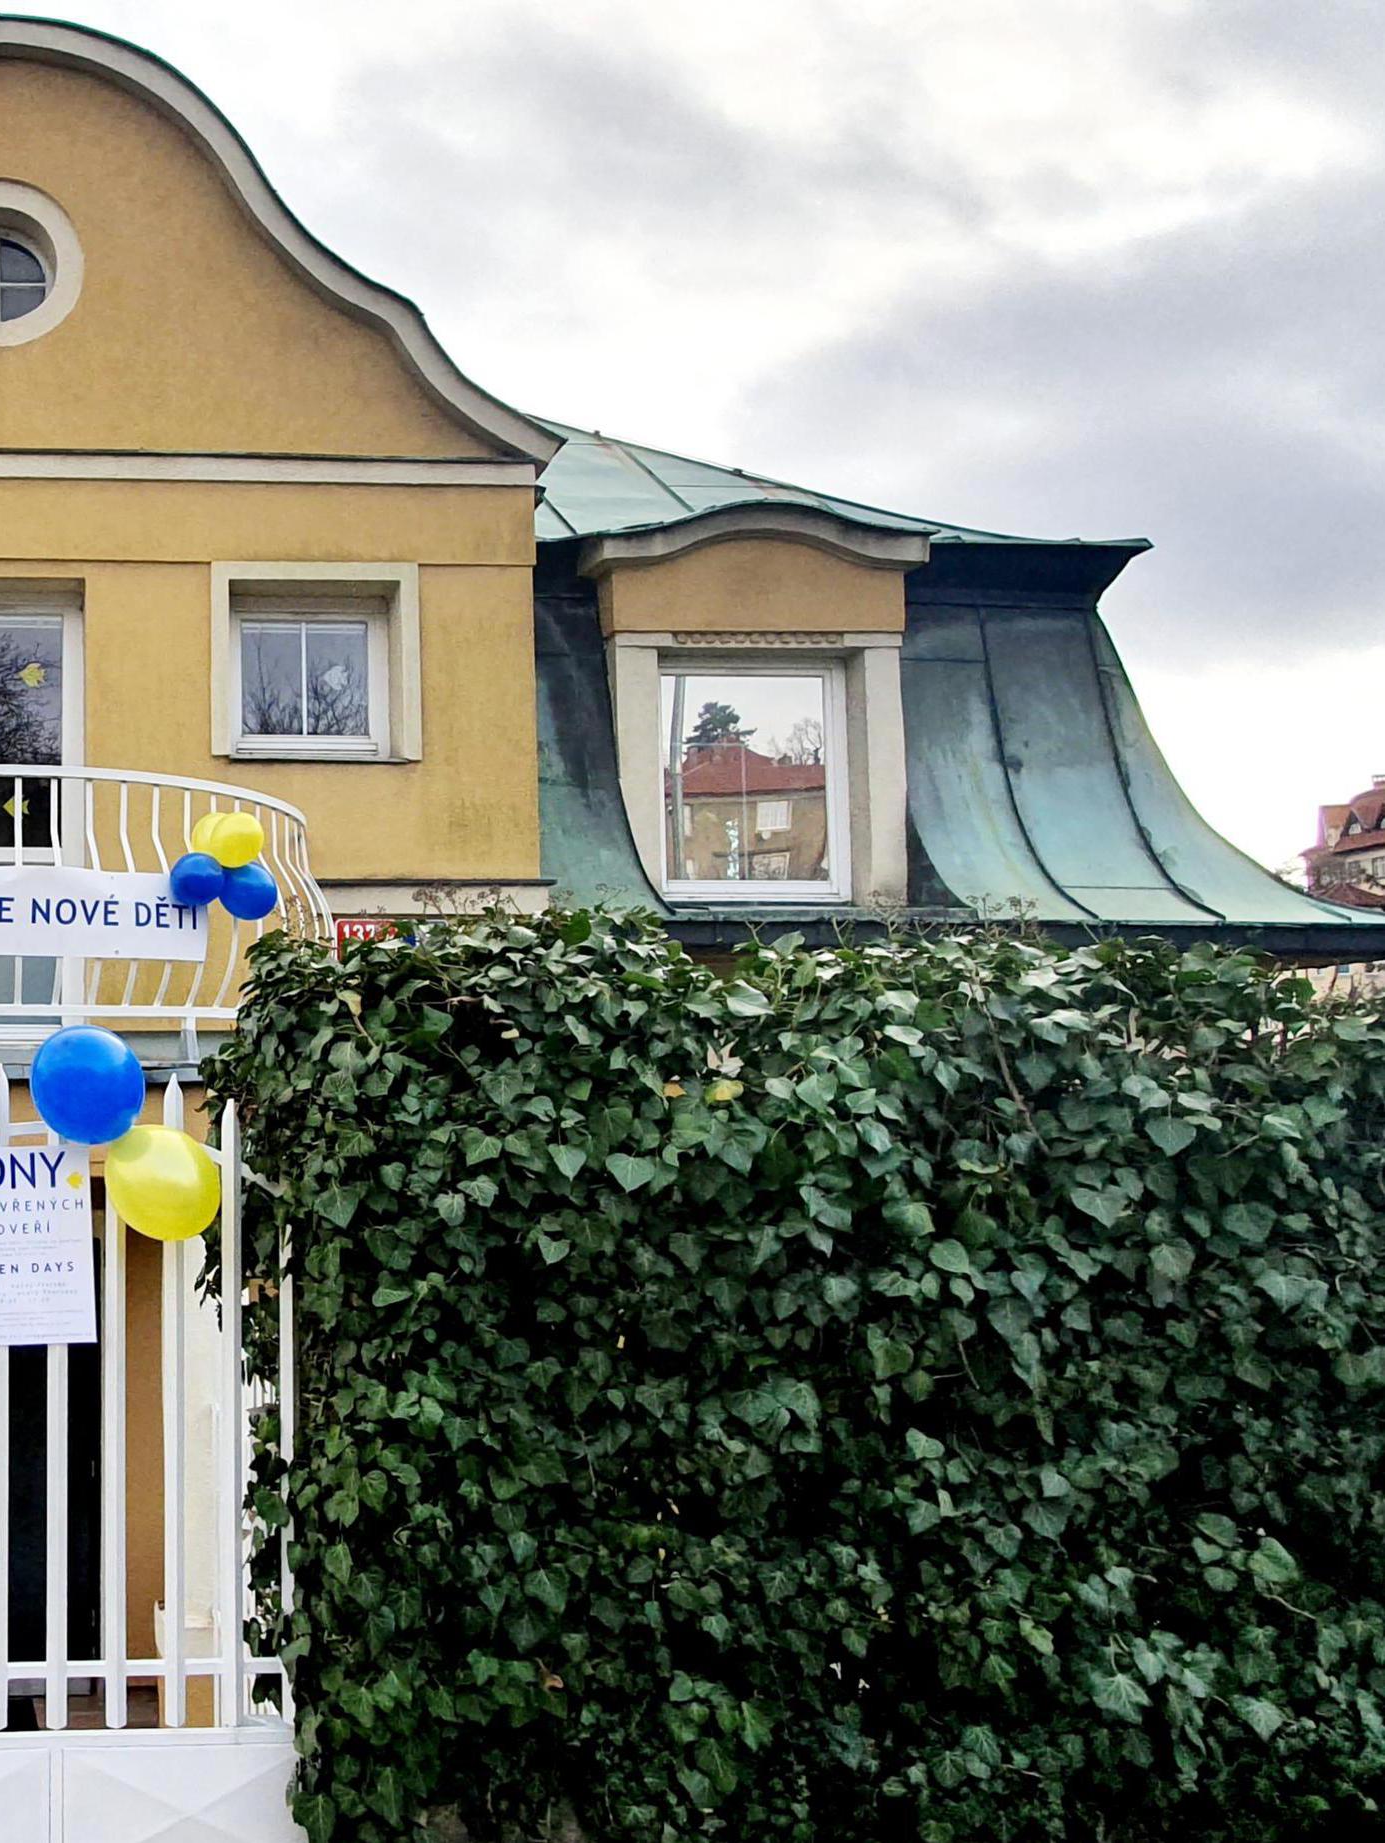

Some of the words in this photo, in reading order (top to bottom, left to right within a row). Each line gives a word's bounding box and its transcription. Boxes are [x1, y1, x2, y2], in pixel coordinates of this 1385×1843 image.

[31, 892, 119, 926] NOVÉ
[135, 896, 198, 930] DĚTI
[31, 1261, 75, 1274] DAYS
